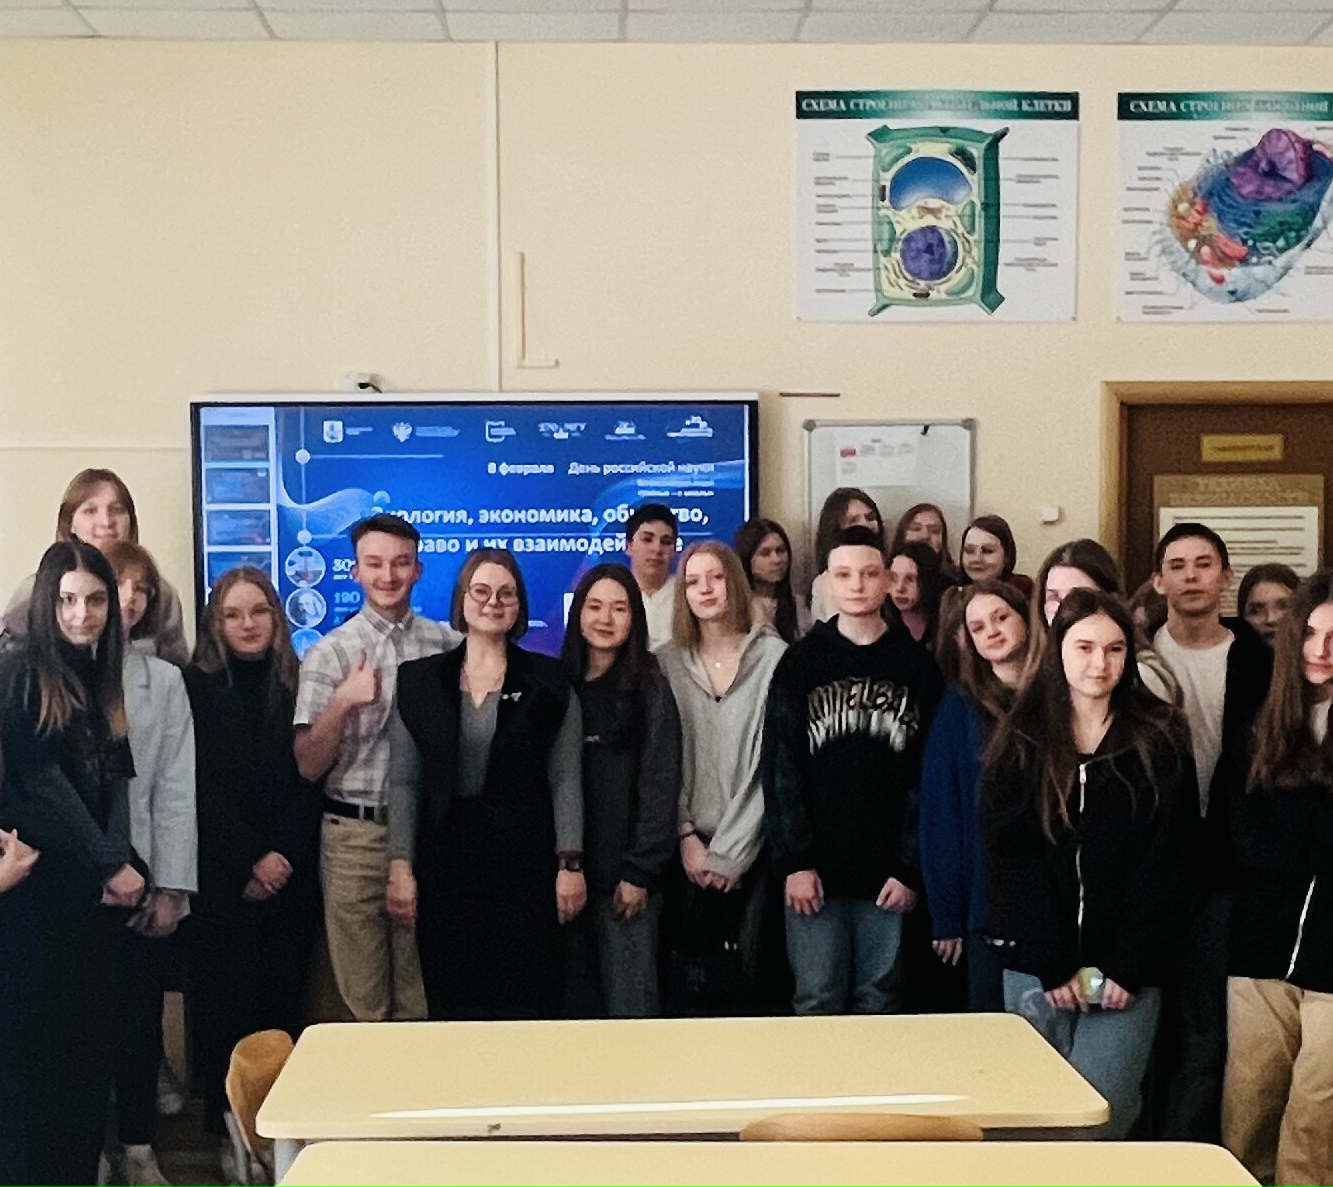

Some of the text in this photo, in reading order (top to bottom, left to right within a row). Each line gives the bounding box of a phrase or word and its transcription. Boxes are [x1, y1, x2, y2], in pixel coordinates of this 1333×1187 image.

[801, 99, 846, 111] СХЕМА
[1021, 99, 1072, 112] КЛЕТКИ
[1130, 100, 1177, 112] СХЕМА
[498, 462, 555, 475] февраля
[567, 462, 601, 475] День
[602, 461, 675, 475] российской
[677, 463, 715, 476] науки
[478, 508, 598, 526] экономика,
[602, 504, 709, 526] обво,
